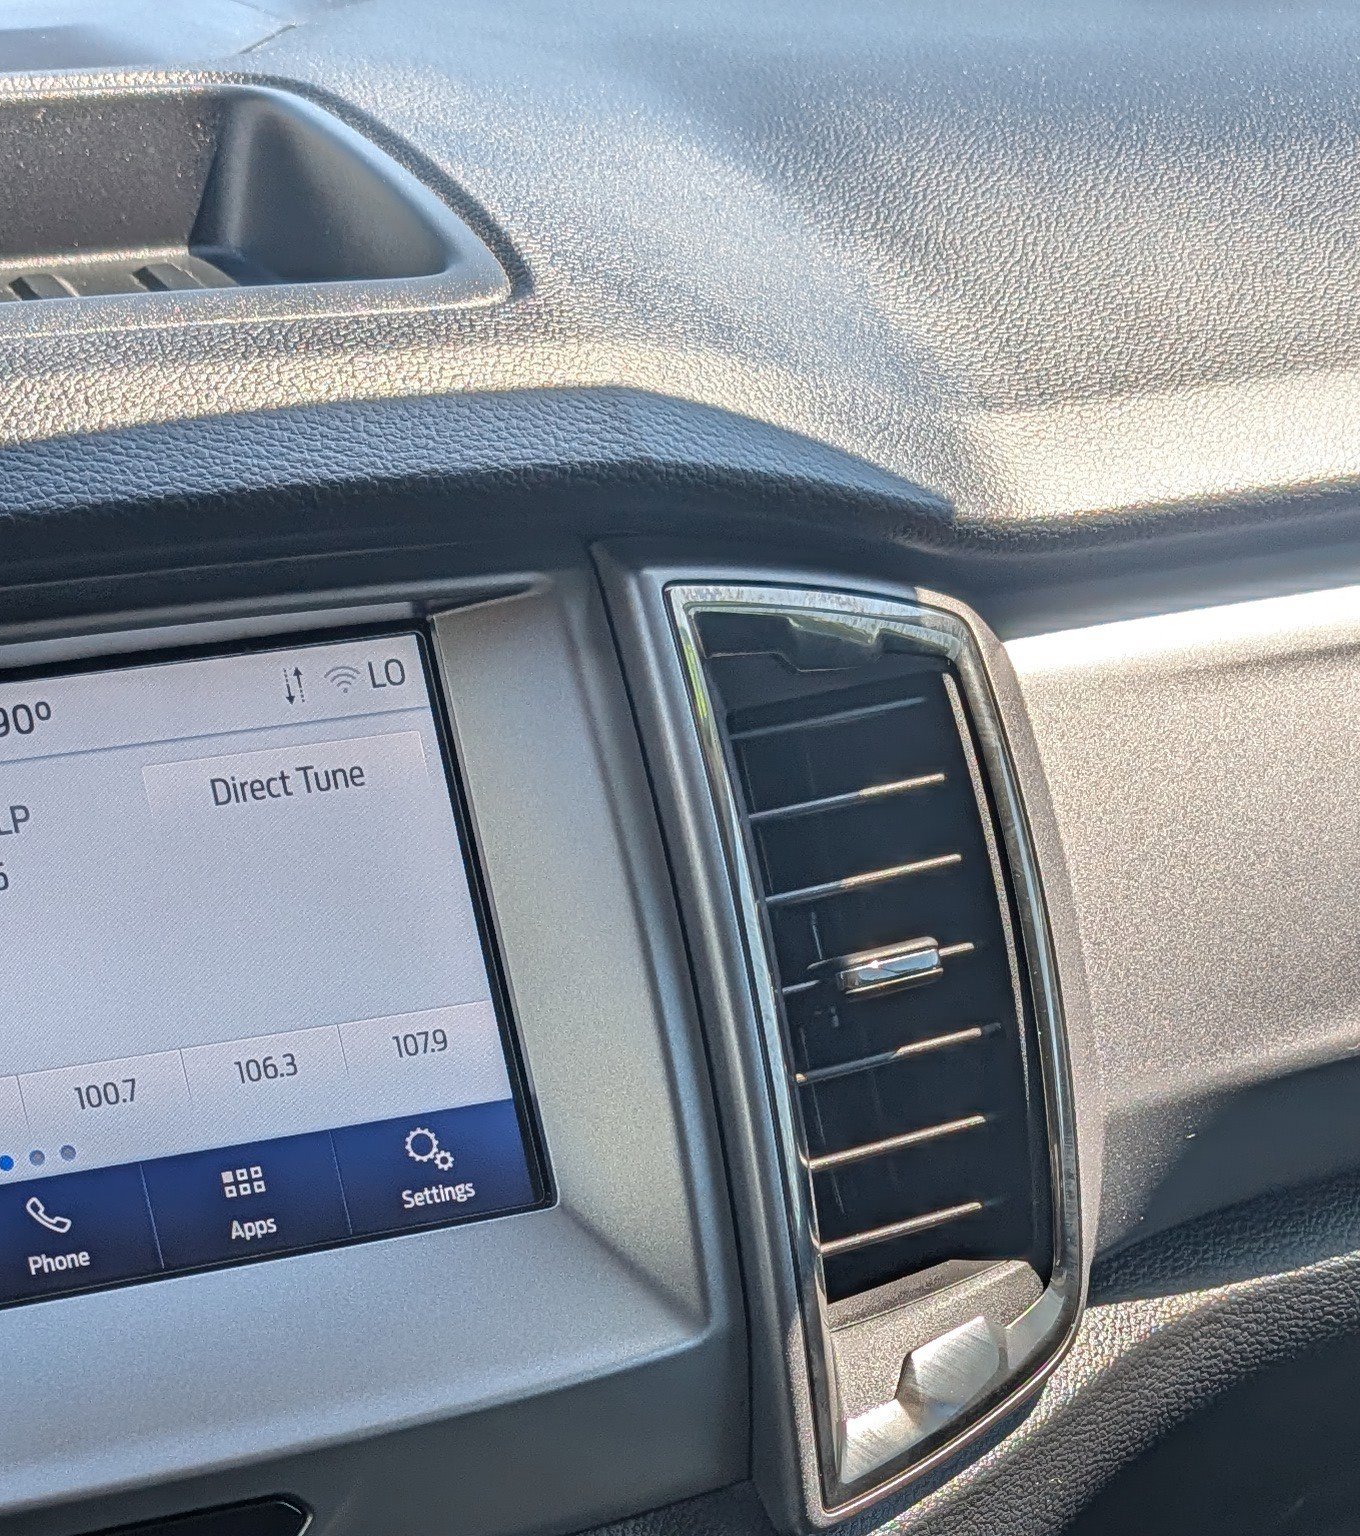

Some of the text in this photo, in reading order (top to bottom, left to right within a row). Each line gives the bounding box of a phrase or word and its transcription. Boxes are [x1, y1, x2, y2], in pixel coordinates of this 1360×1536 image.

[367, 658, 407, 691] LO
[210, 763, 367, 807] Direct Tune
[391, 1028, 449, 1060] 107.9
[233, 1052, 299, 1085] 106.3
[73, 1078, 138, 1111] 100.7
[401, 1179, 477, 1210] Settings
[230, 1214, 278, 1244] Apps
[28, 1246, 91, 1276] Phone
